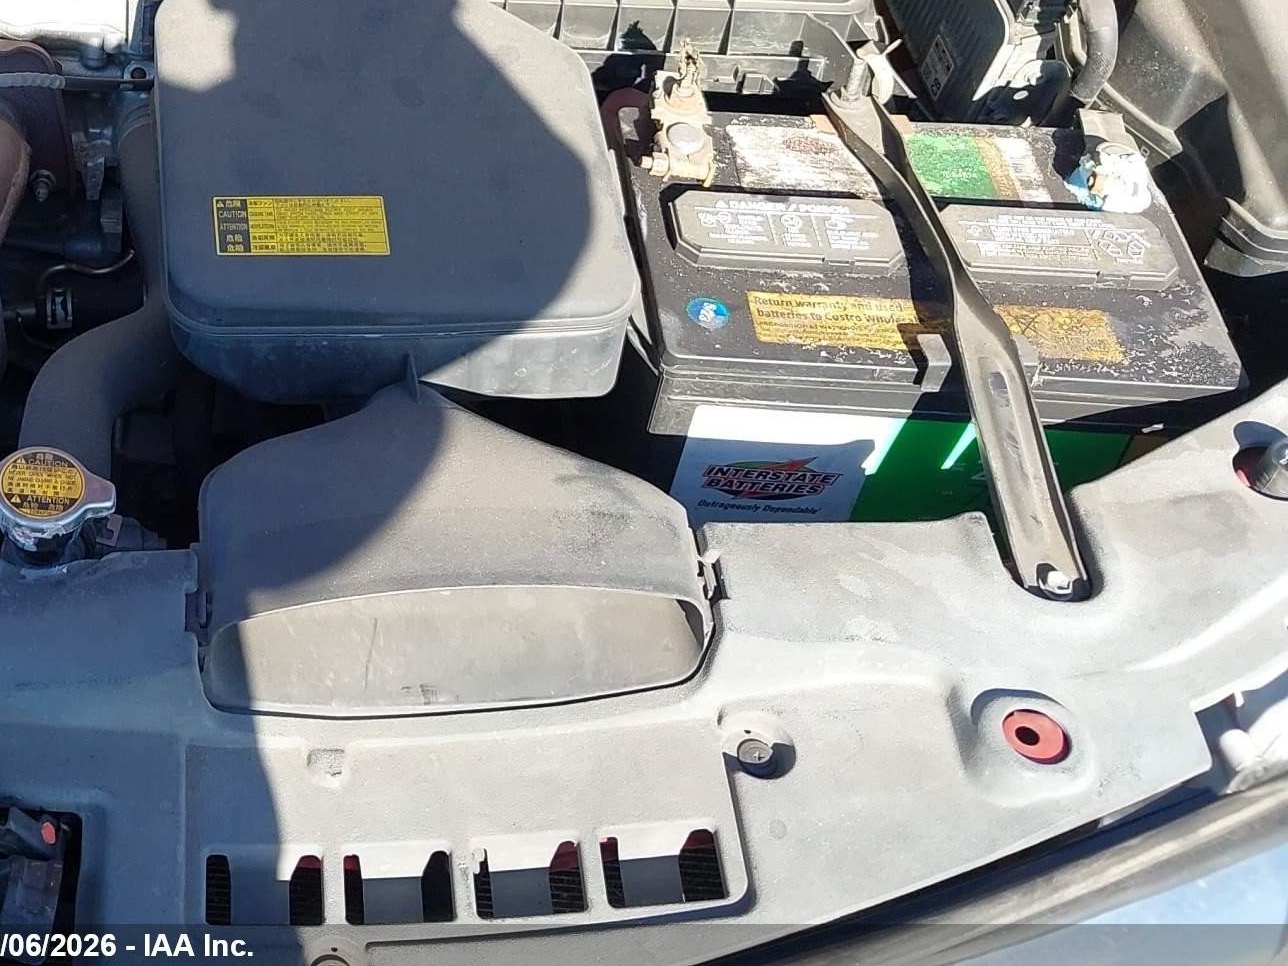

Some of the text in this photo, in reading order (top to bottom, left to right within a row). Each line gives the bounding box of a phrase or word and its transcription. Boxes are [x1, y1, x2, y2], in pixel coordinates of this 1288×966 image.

[218, 210, 247, 219] CAUTION
[219, 223, 248, 231] ATTENTION
[754, 296, 903, 312] Return warranty and used
[756, 307, 808, 320] batteries
[811, 313, 823, 321] to
[28, 458, 68, 467] CAUTION
[706, 465, 838, 484] INTERSTATE
[706, 478, 824, 495] BATTERIES
[26, 495, 71, 506] ATTENTION
[697, 499, 820, 515] Outrageously Dependable
